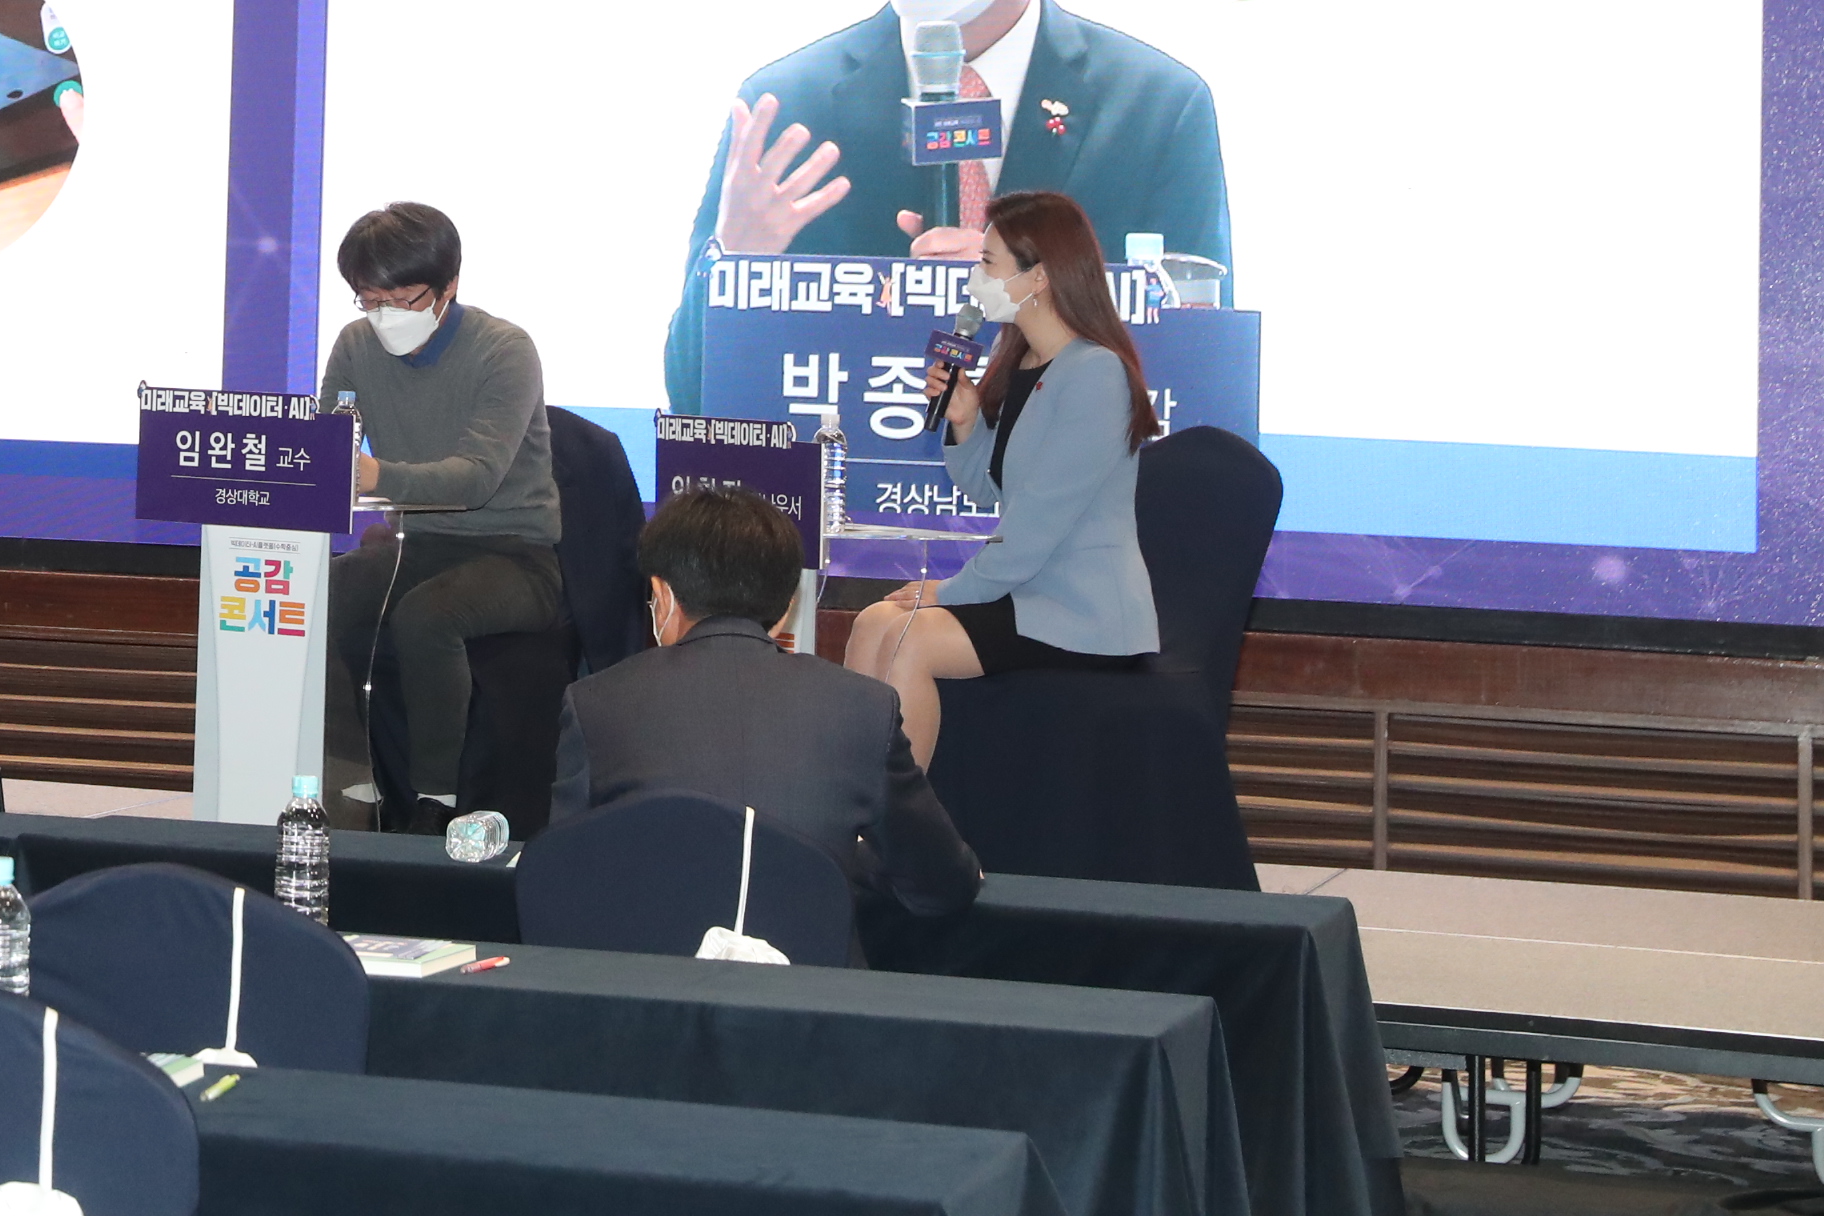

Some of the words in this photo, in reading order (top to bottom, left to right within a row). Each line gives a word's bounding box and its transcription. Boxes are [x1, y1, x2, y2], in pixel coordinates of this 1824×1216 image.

[708, 258, 876, 315] 미래교육
[140, 389, 206, 415] 미래교육
[657, 416, 707, 443] 미래교육
[276, 446, 311, 471] 교수
[215, 487, 271, 506] 경상대학교
[234, 556, 294, 596] 공감
[219, 595, 306, 637] 콘서트
